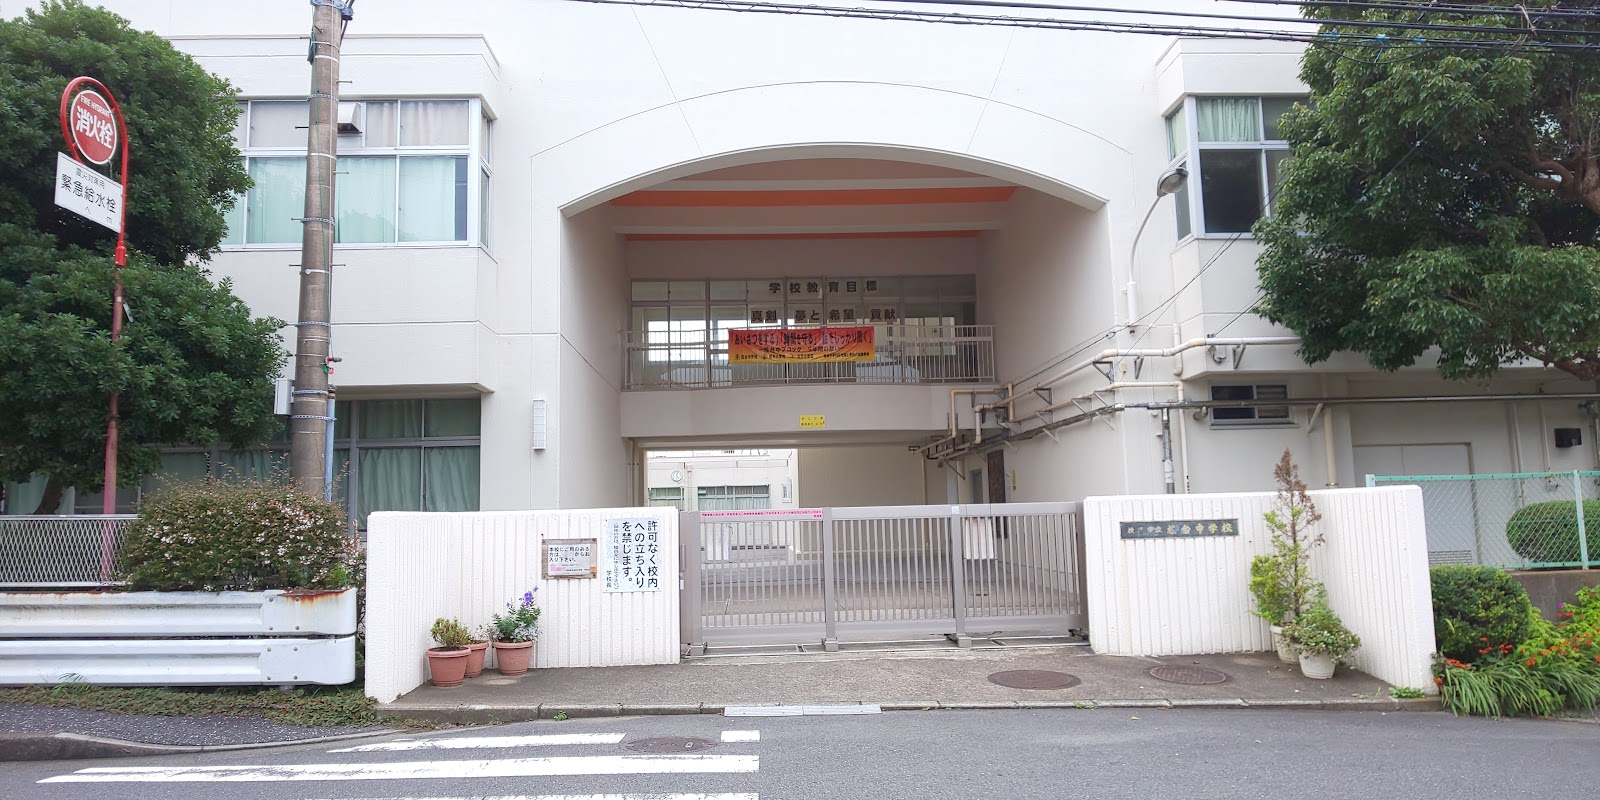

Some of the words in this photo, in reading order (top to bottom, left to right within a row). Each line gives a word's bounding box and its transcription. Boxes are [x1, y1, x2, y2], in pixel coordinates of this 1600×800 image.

[75, 105, 113, 149] 消火栓
[80, 95, 92, 107] FIRE
[91, 102, 110, 118] HYDRANT
[61, 173, 116, 214] 緊急給水栓
[769, 280, 878, 294] 学校教育目標
[752, 310, 778, 322] 真剣
[870, 308, 896, 321] 貢献
[621, 521, 633, 582] を禁じます。
[634, 522, 646, 588] への立ち入り
[647, 520, 659, 588] 許可なく校内
